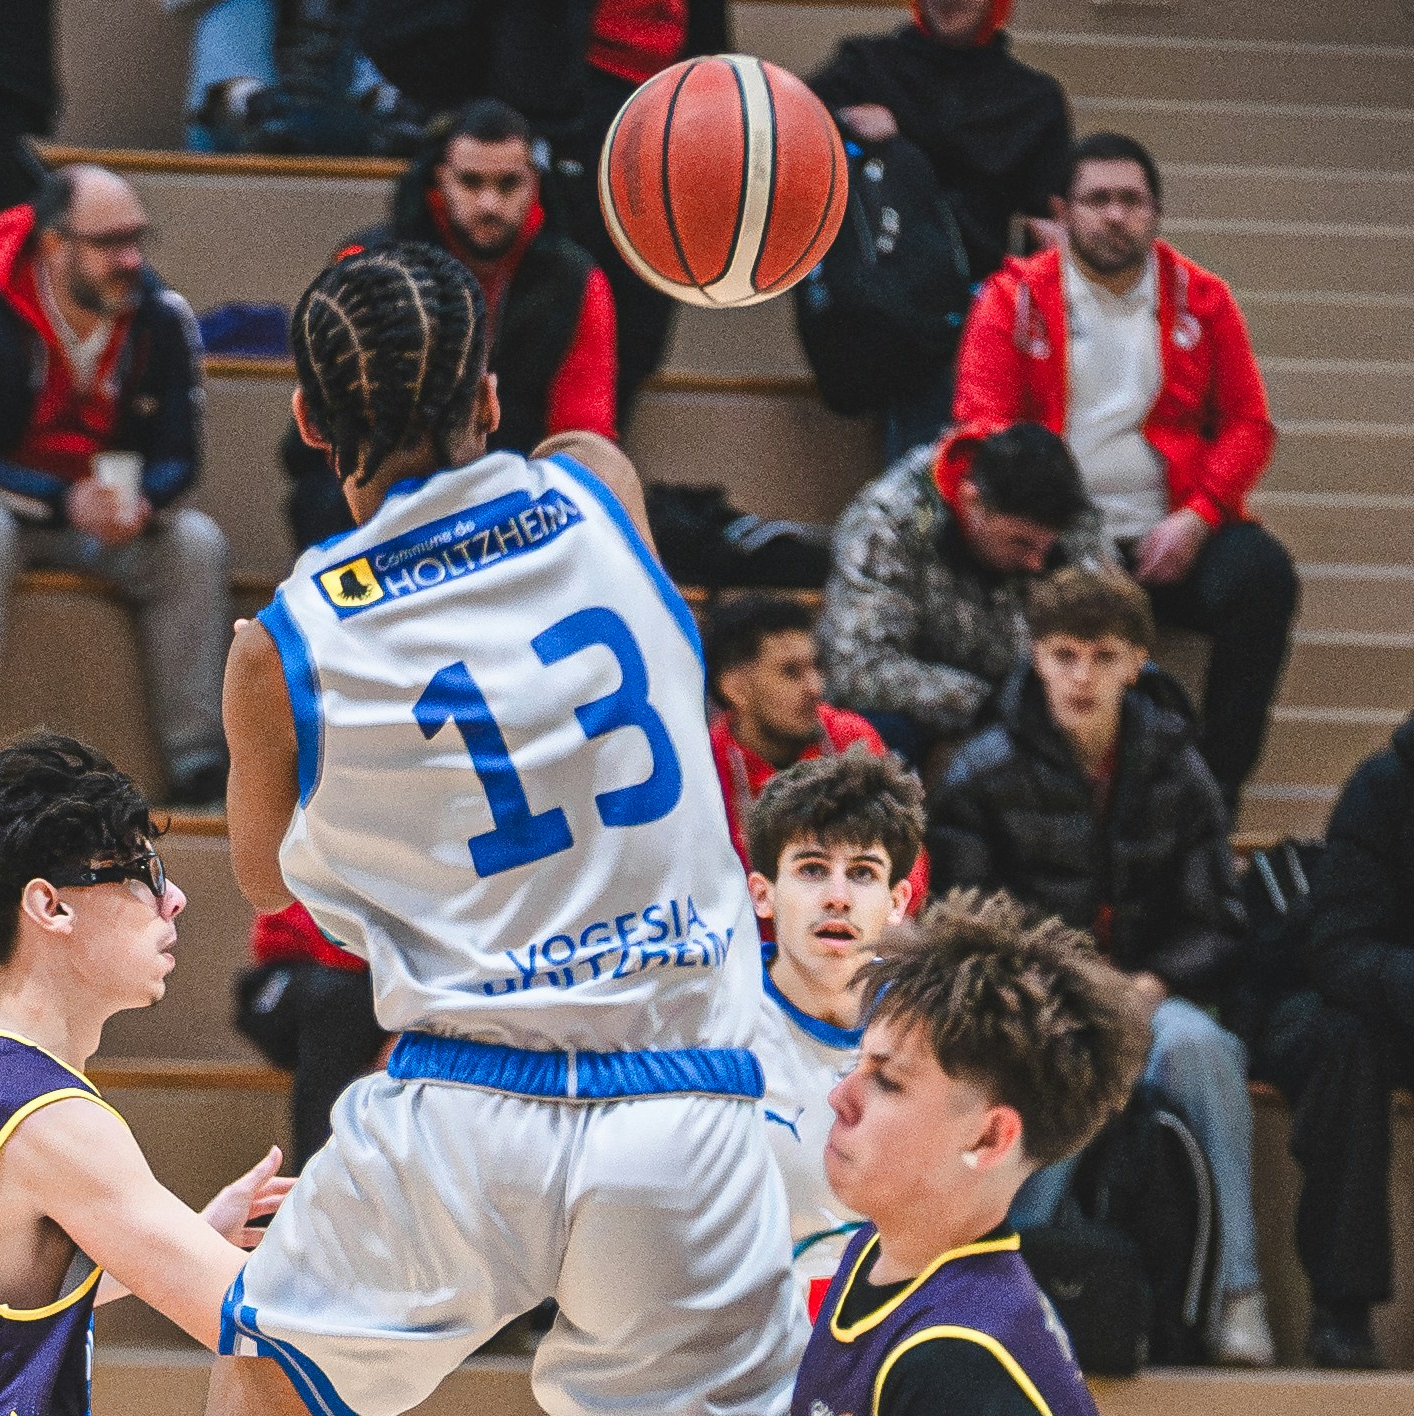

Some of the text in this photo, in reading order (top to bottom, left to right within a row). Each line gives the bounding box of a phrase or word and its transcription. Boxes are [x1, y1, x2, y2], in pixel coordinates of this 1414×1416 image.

[374, 531, 453, 571] Commune
[383, 496, 579, 597] HOLTZHEIM
[412, 606, 683, 878] 13
[505, 895, 708, 975] VOGESIA
